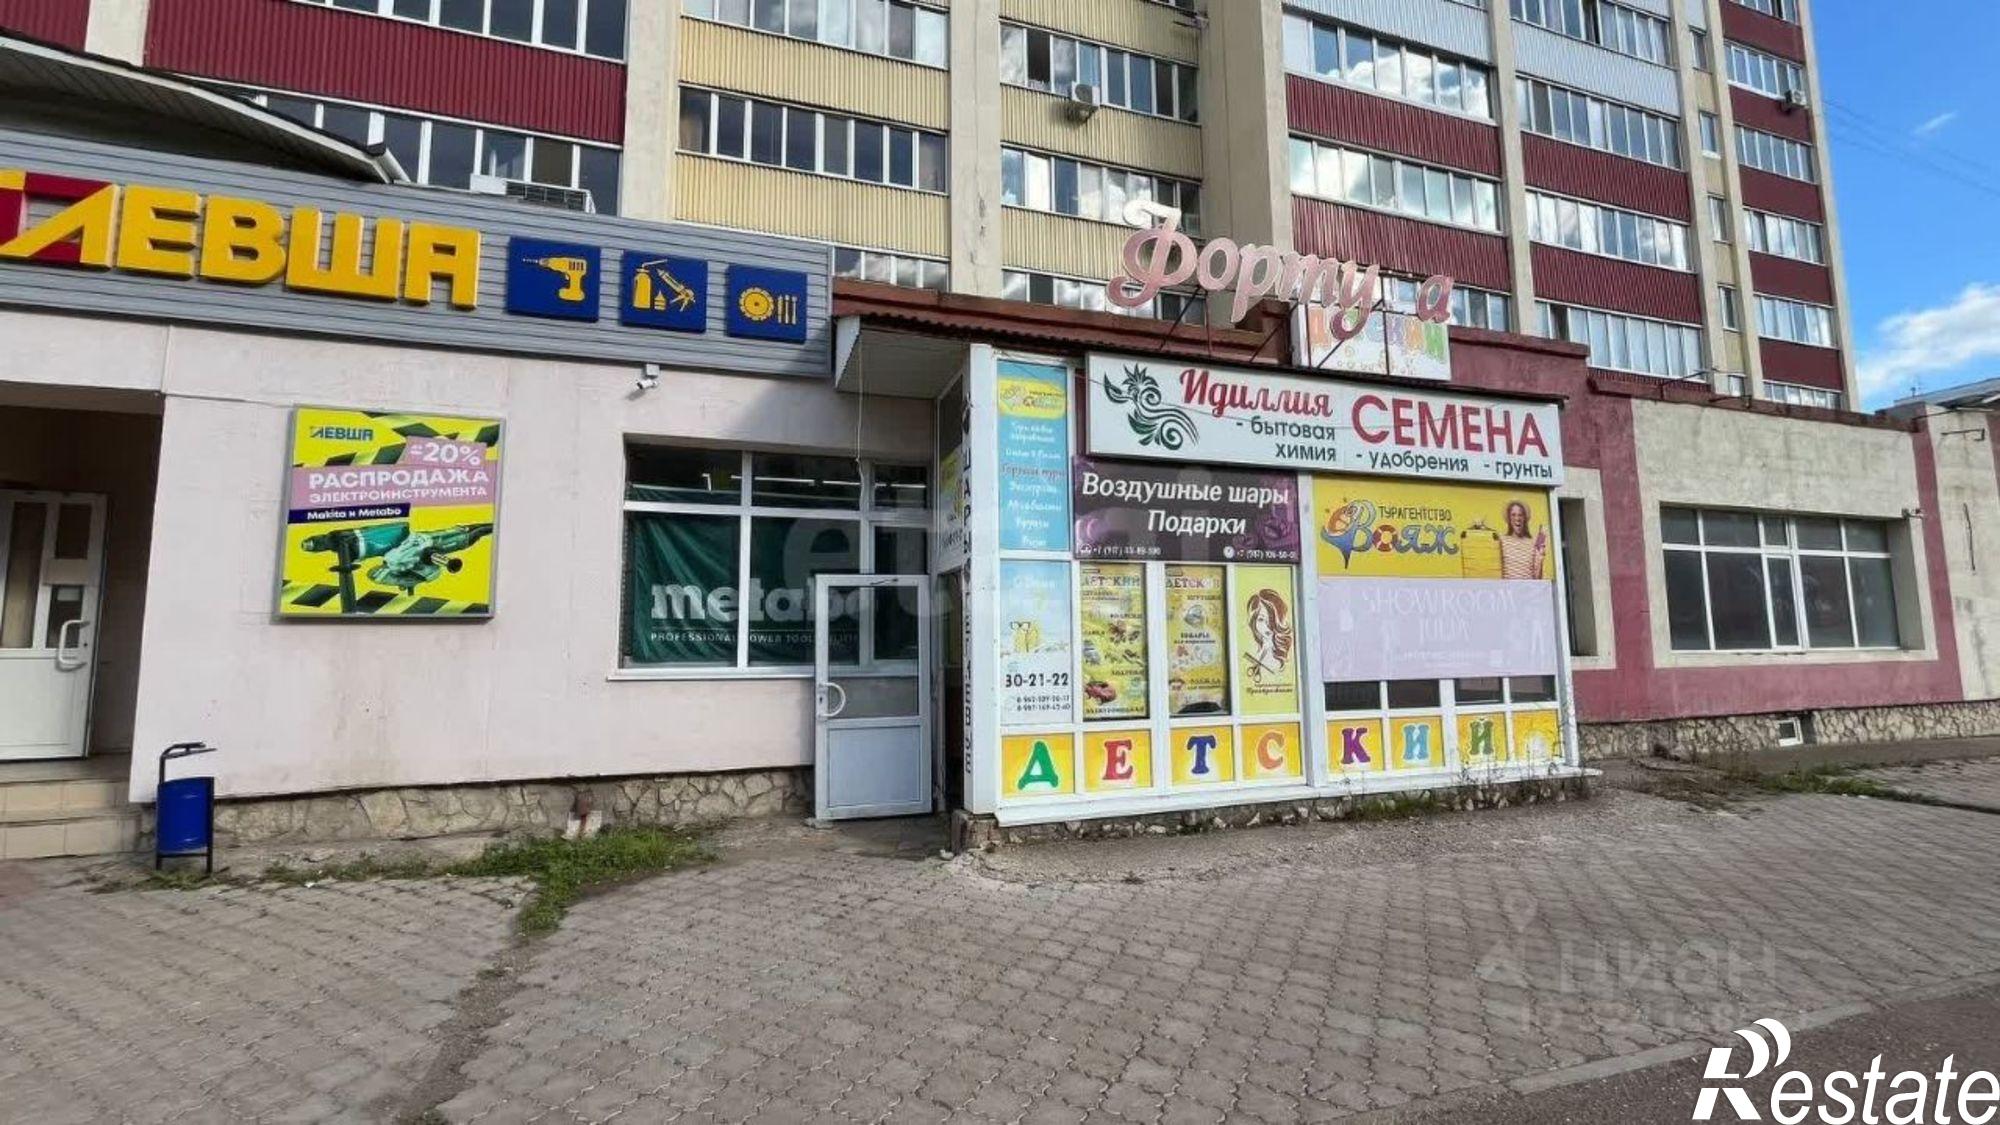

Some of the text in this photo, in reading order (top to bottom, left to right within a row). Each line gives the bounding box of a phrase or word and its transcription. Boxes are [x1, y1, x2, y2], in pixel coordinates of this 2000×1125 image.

[0, 183, 482, 310] ЛЕВША
[1179, 369, 1334, 418] Идиллия
[309, 426, 374, 441] ЛЕВША
[1251, 416, 1336, 441] бытовая
[1352, 395, 1549, 457] СЕМЕНА
[1275, 443, 1337, 461] химия
[1369, 450, 1553, 479] удобрения грунты
[309, 469, 489, 489] РАСПРОДАЖА
[1082, 472, 1289, 509] Воздушные шары
[309, 486, 488, 503] ЭЛЕКТРОИНСТРУМЕНТА
[307, 510, 346, 520] Makita
[358, 507, 402, 517] Metabo
[1148, 508, 1246, 538] Подарки
[1377, 506, 1453, 521] ТУРАГЕНТСТВО
[1320, 499, 1460, 570] Вояж
[1005, 672, 1069, 688] 30-21-22
[1017, 717, 1497, 791] ДЕТСКИЙ
